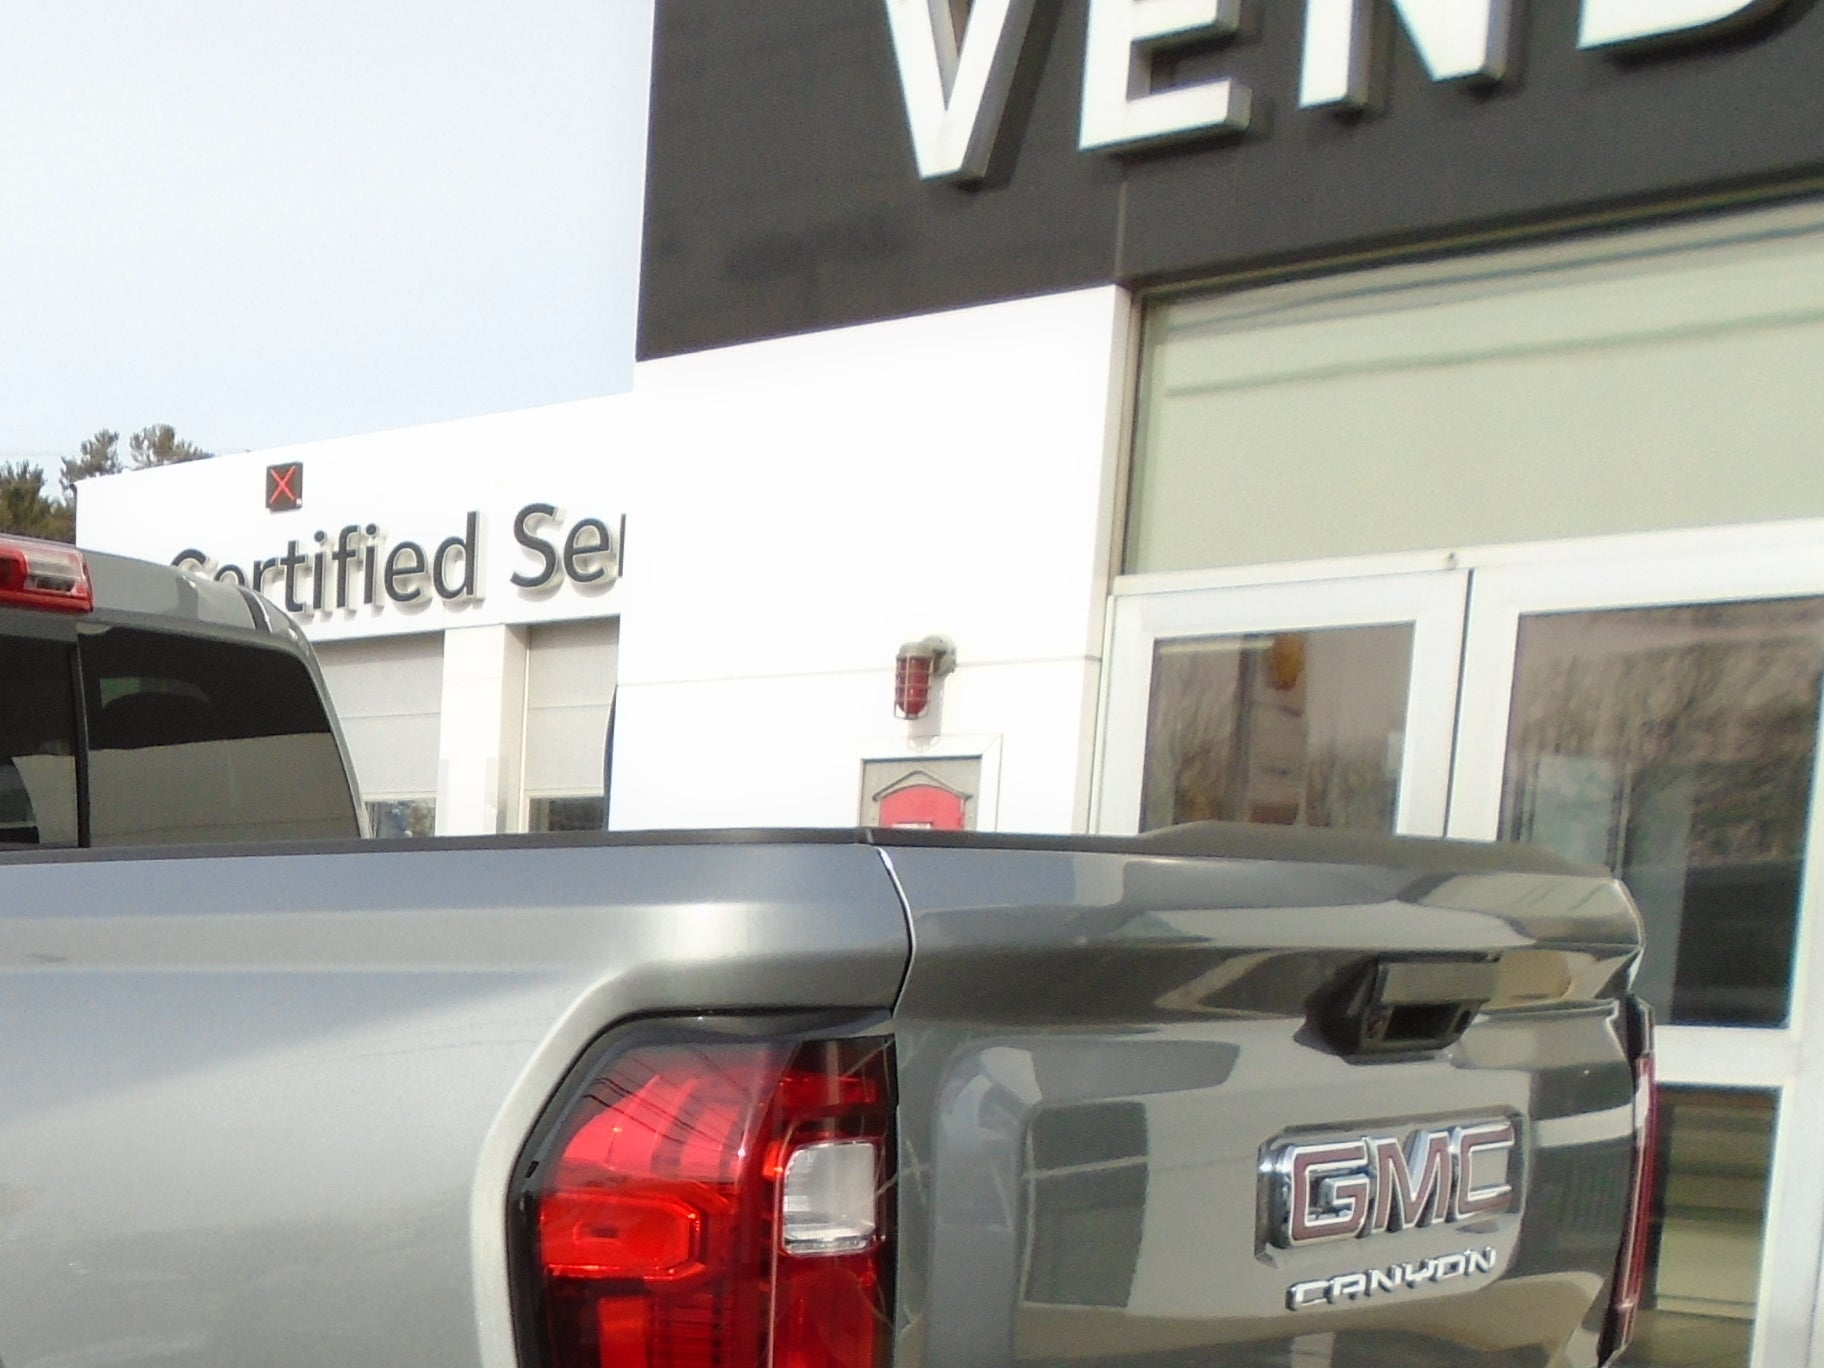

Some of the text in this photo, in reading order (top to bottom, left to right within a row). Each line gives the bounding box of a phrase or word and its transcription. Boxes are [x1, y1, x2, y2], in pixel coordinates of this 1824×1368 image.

[884, 0, 1781, 182] VE
[1276, 1118, 1516, 1247] GMC
[1288, 1246, 1497, 1310] CANYON
